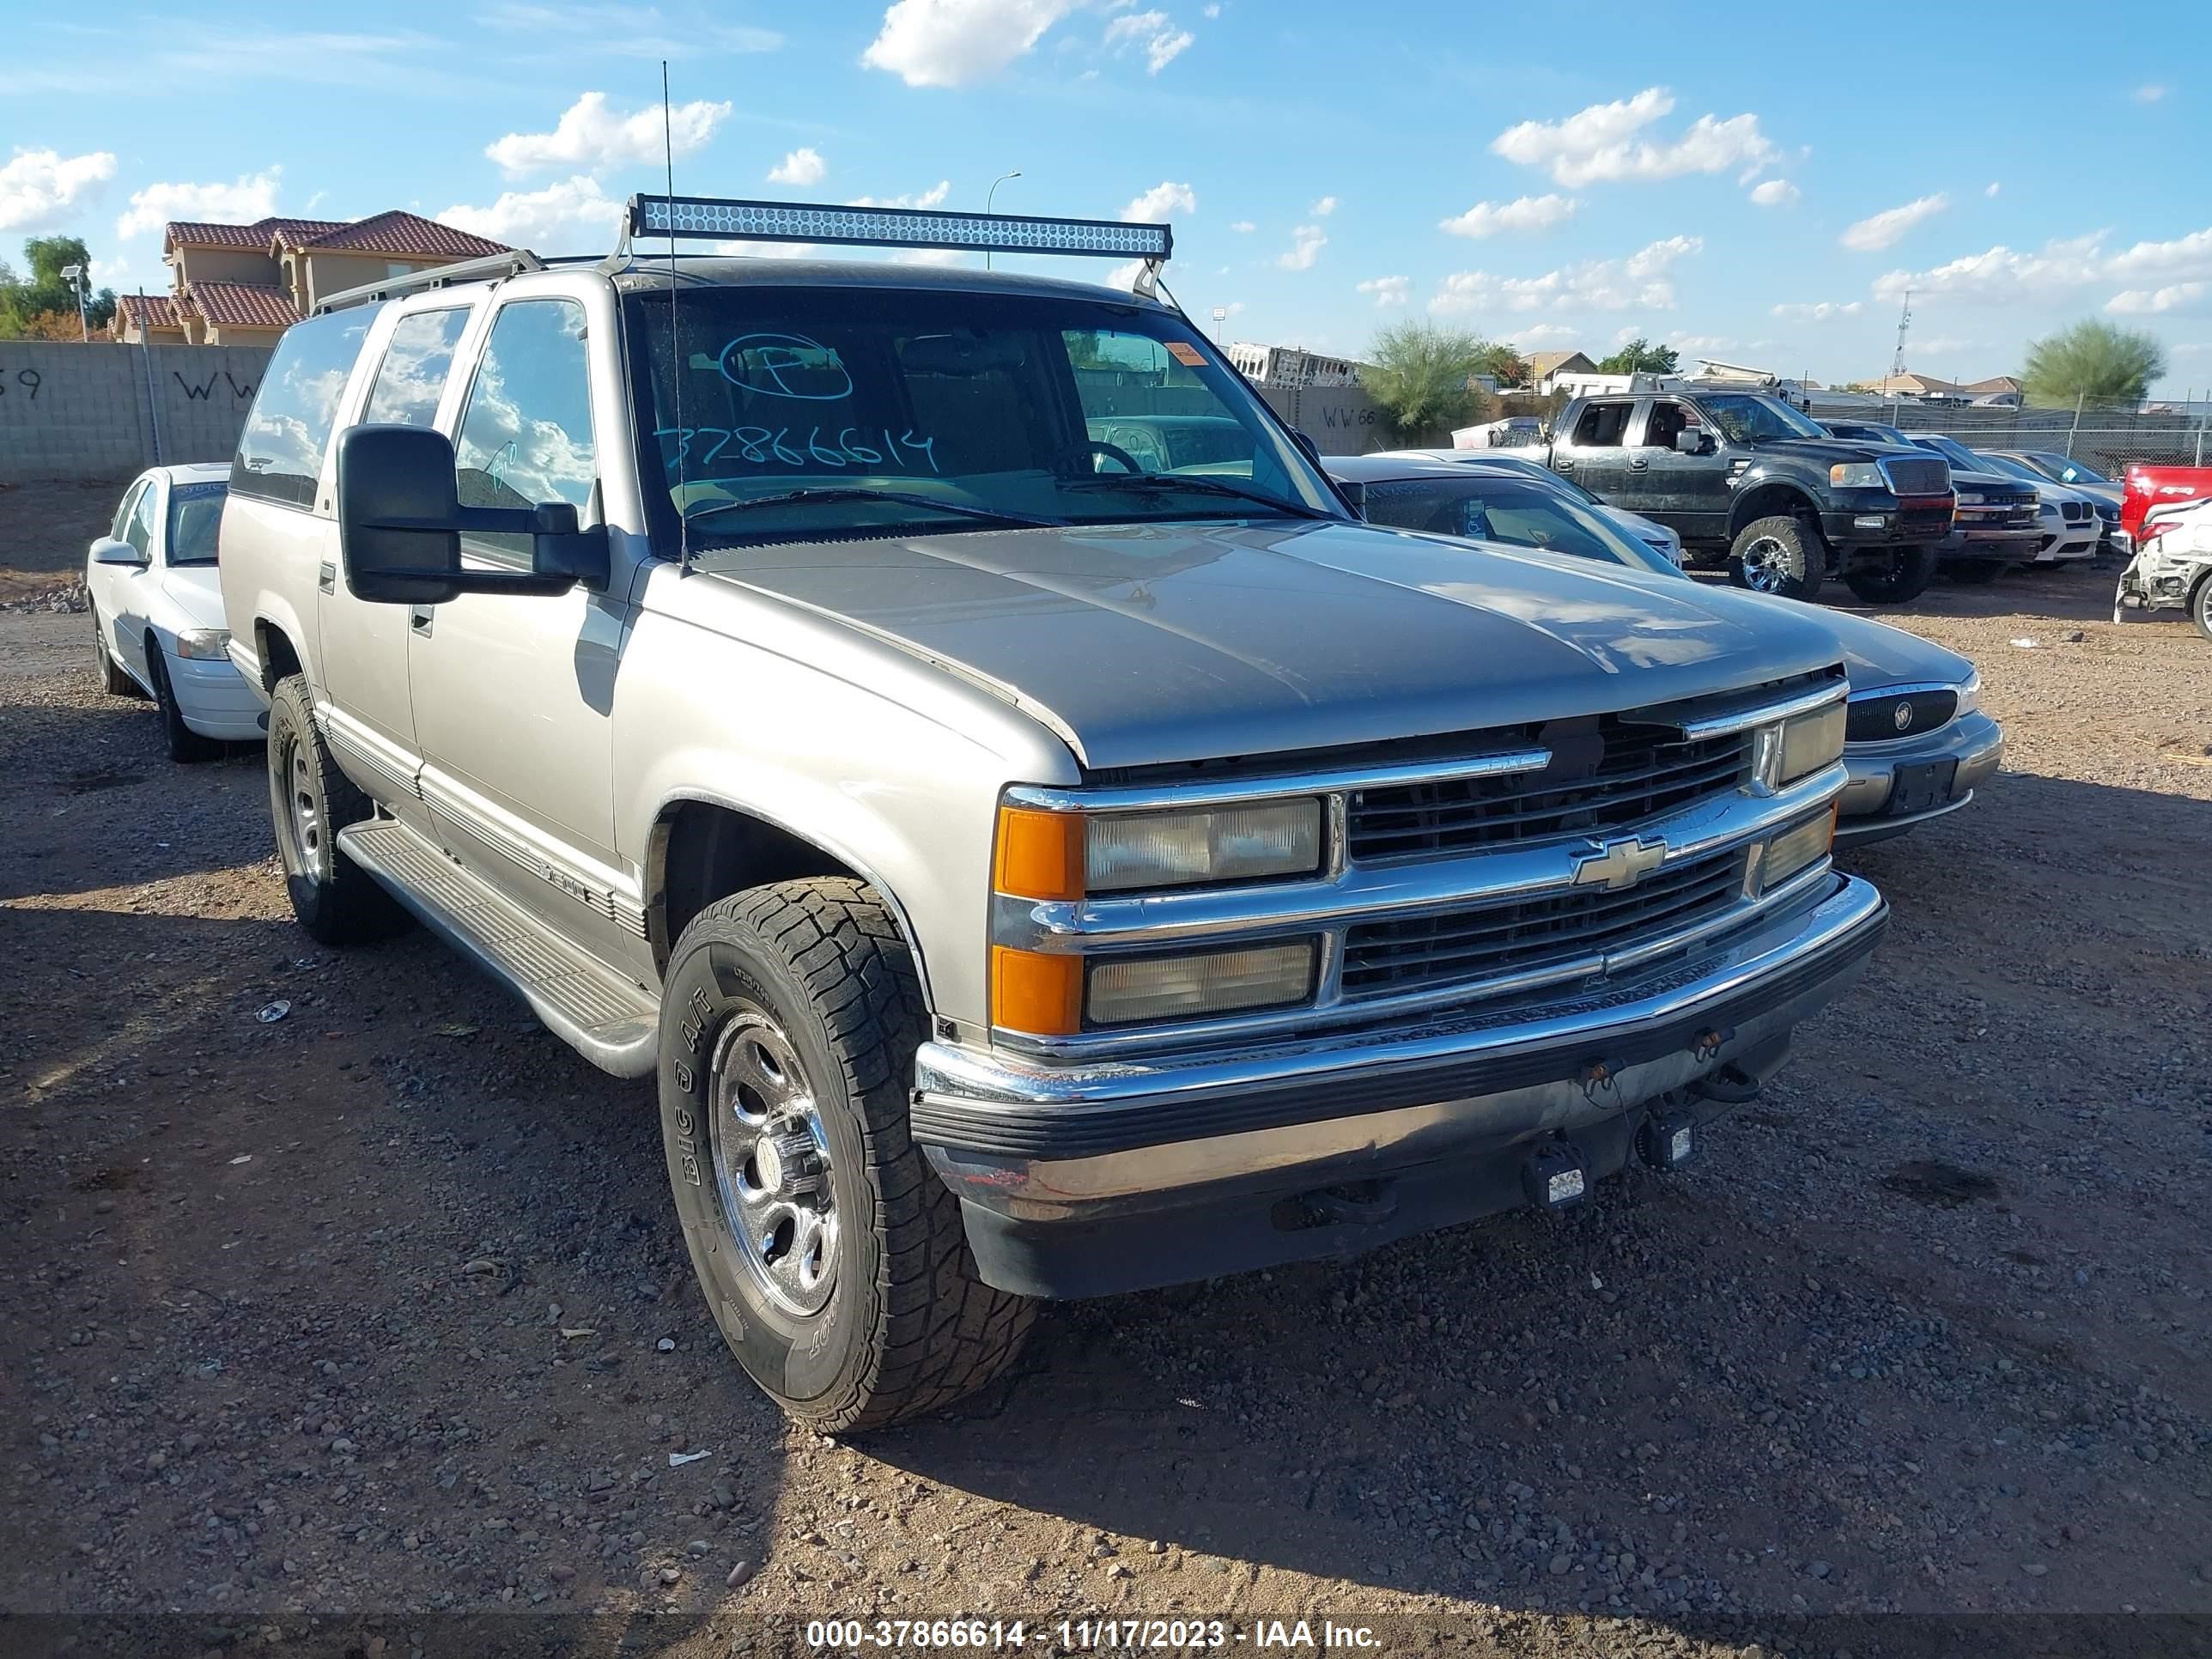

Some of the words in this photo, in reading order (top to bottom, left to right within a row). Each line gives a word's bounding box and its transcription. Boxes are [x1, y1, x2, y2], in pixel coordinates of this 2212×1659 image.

[652, 426, 939, 473] 37866614
[679, 986, 714, 1054] A/T
[674, 1105, 702, 1187] BIG
